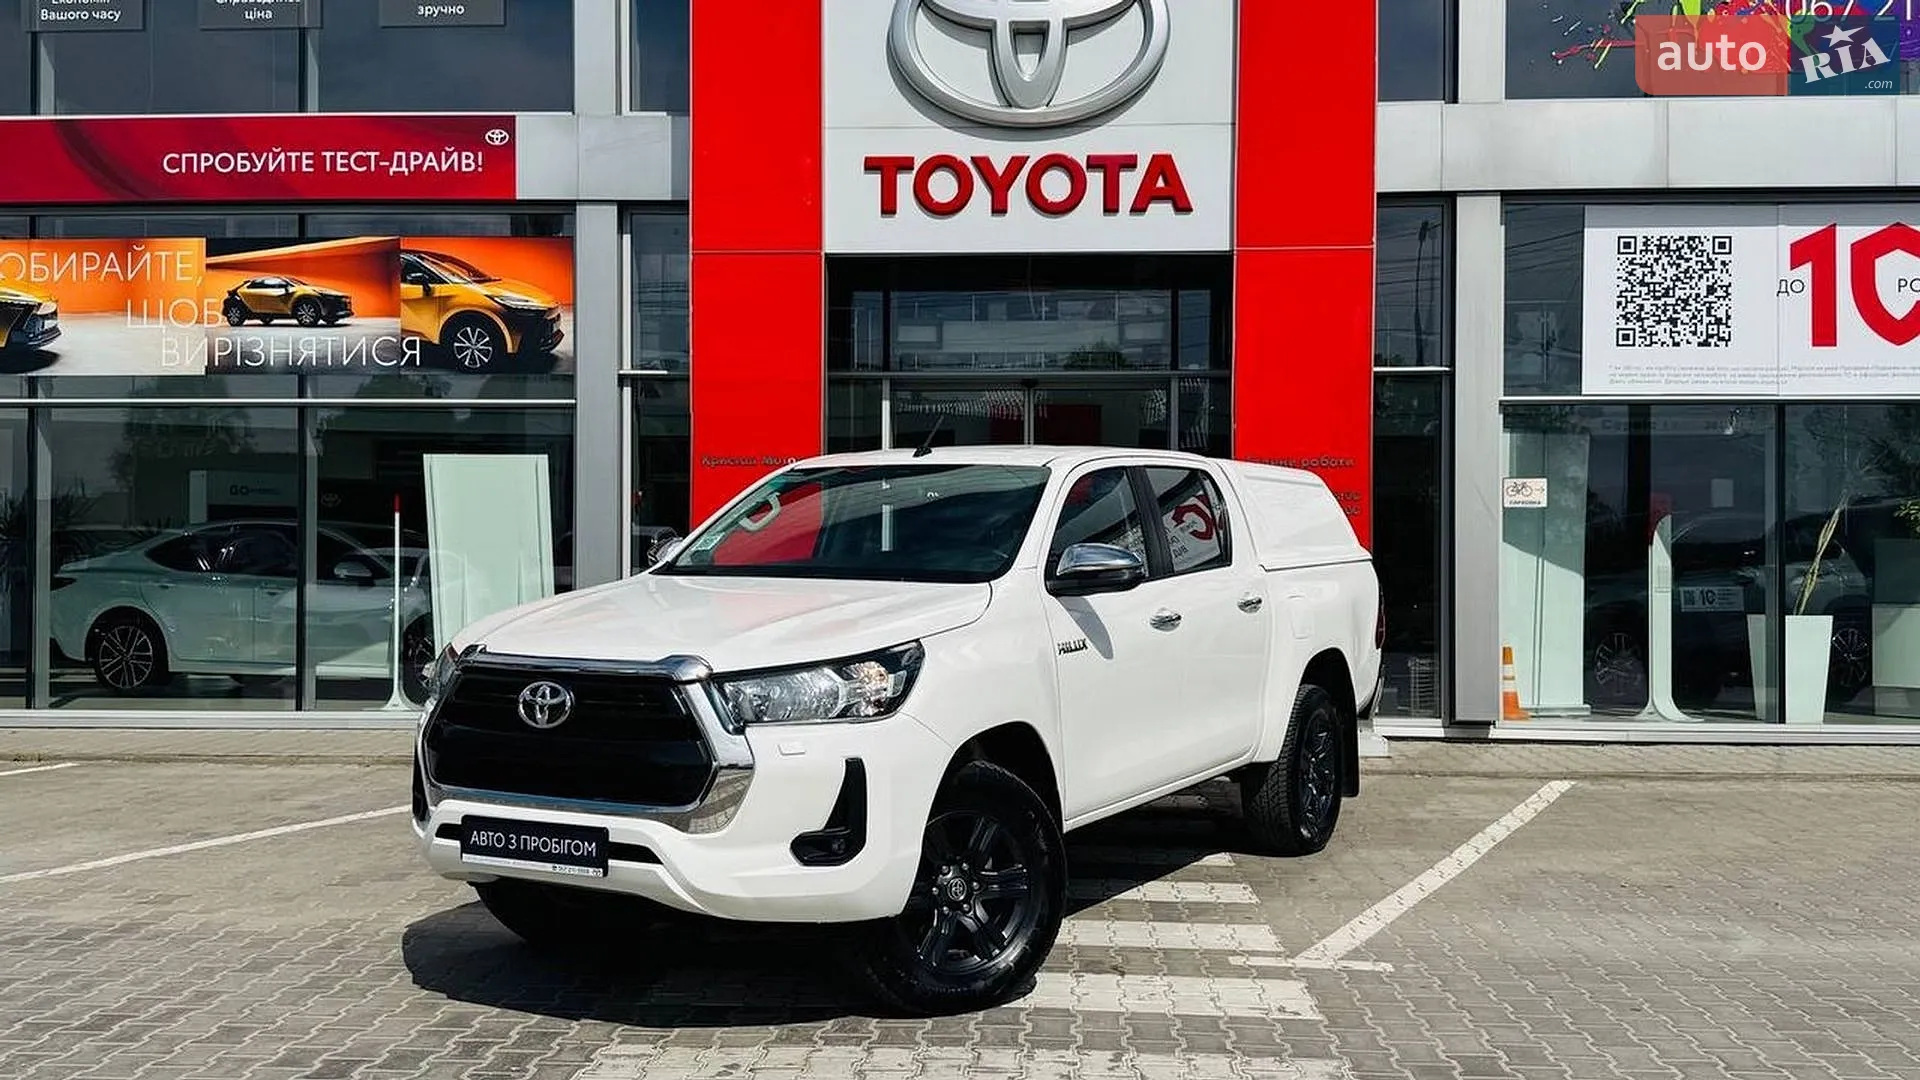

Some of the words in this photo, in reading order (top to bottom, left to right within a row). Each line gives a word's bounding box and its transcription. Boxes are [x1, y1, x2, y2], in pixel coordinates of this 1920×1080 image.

[40, 8, 90, 21] Вашого
[91, 10, 122, 22] часу
[244, 8, 273, 20] ціна
[417, 5, 465, 17] зручно
[163, 147, 315, 175] СПРОБУЙТЕ
[321, 148, 484, 175] ТЕСТ-ДРАЙВ!
[863, 153, 1193, 217] TOYOTA
[1776, 278, 1806, 297] ДО
[1790, 221, 1920, 347] 10
[126, 298, 221, 333] ЩОБ
[161, 335, 421, 367] ВИРІЗНЯТИСЯ
[1057, 637, 1089, 656] HILUX
[470, 830, 505, 848] АВТО
[520, 835, 597, 857] ПРОБІГОМ
